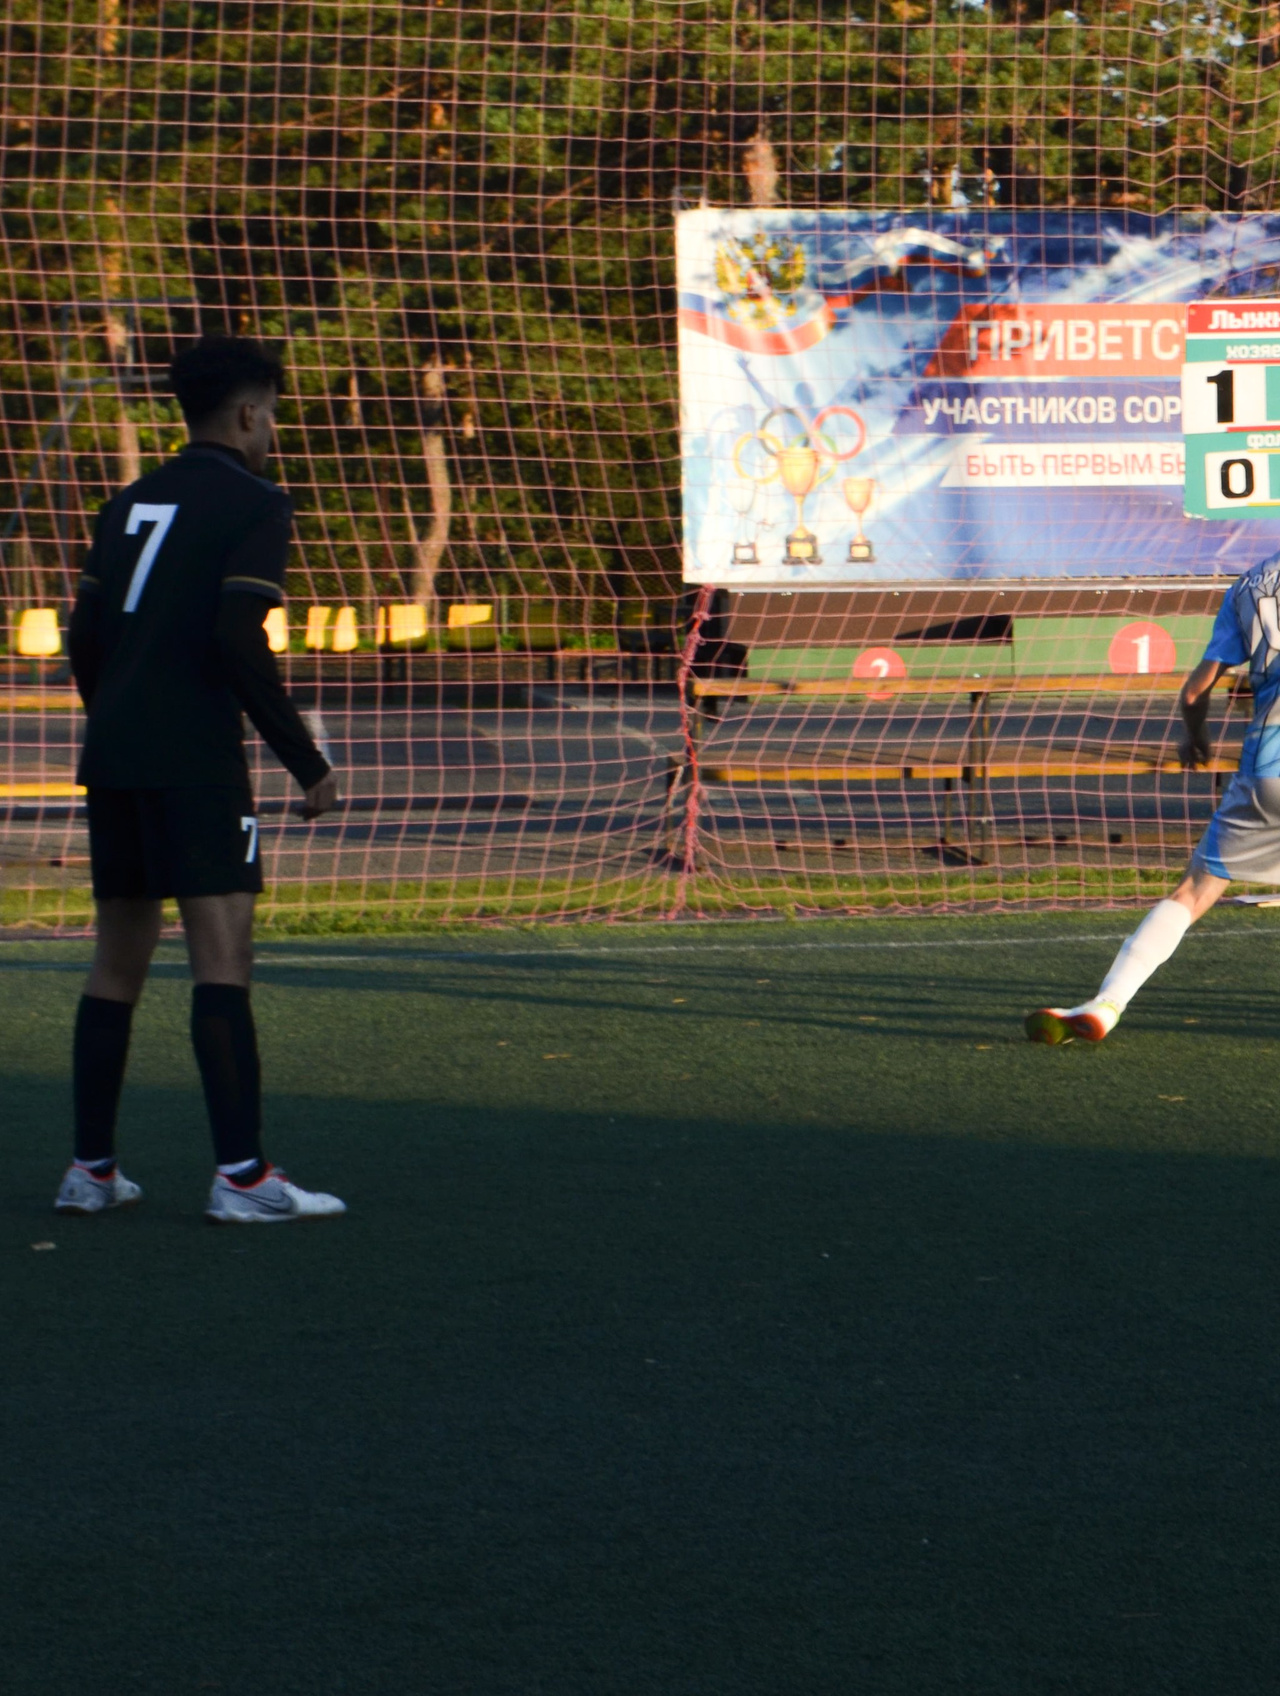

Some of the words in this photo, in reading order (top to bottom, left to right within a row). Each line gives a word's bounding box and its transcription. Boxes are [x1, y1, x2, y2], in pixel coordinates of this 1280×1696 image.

[968, 318, 1186, 361] ПРИВЕТС
[923, 396, 1117, 425] УЧАСТНИКОВ
[1206, 369, 1234, 423] 1
[966, 455, 1035, 476] БЫТЬ
[1042, 454, 1153, 476] ПЕРВЫМ
[1220, 458, 1254, 499] 0
[122, 503, 179, 613] 7
[1131, 634, 1150, 673] 1
[240, 816, 258, 864] 7
